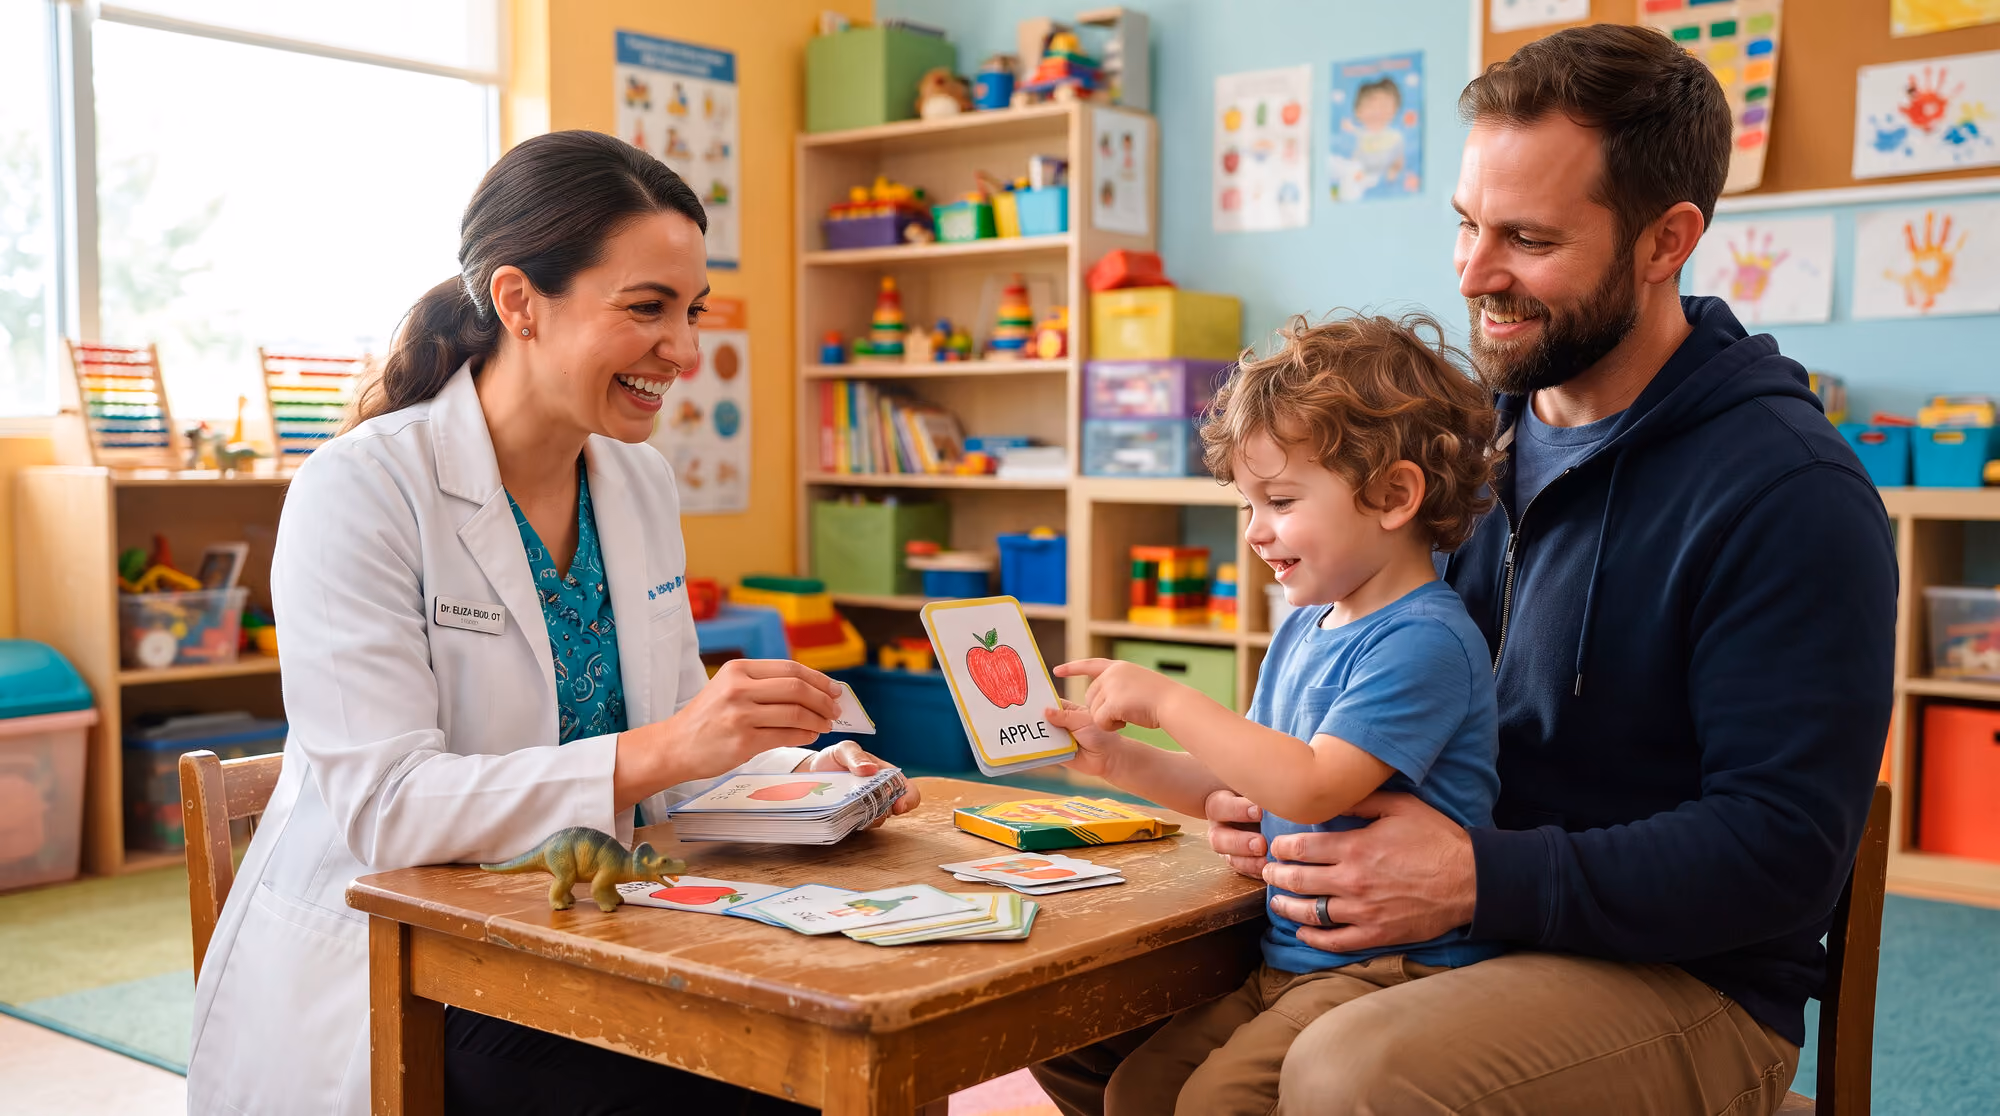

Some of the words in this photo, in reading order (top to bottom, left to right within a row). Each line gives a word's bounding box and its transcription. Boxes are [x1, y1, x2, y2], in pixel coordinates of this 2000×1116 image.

[440, 603, 451, 613] Dr.
[453, 605, 472, 616] ELIZA
[491, 612, 501, 622] OT
[999, 721, 1050, 745] APPLE
